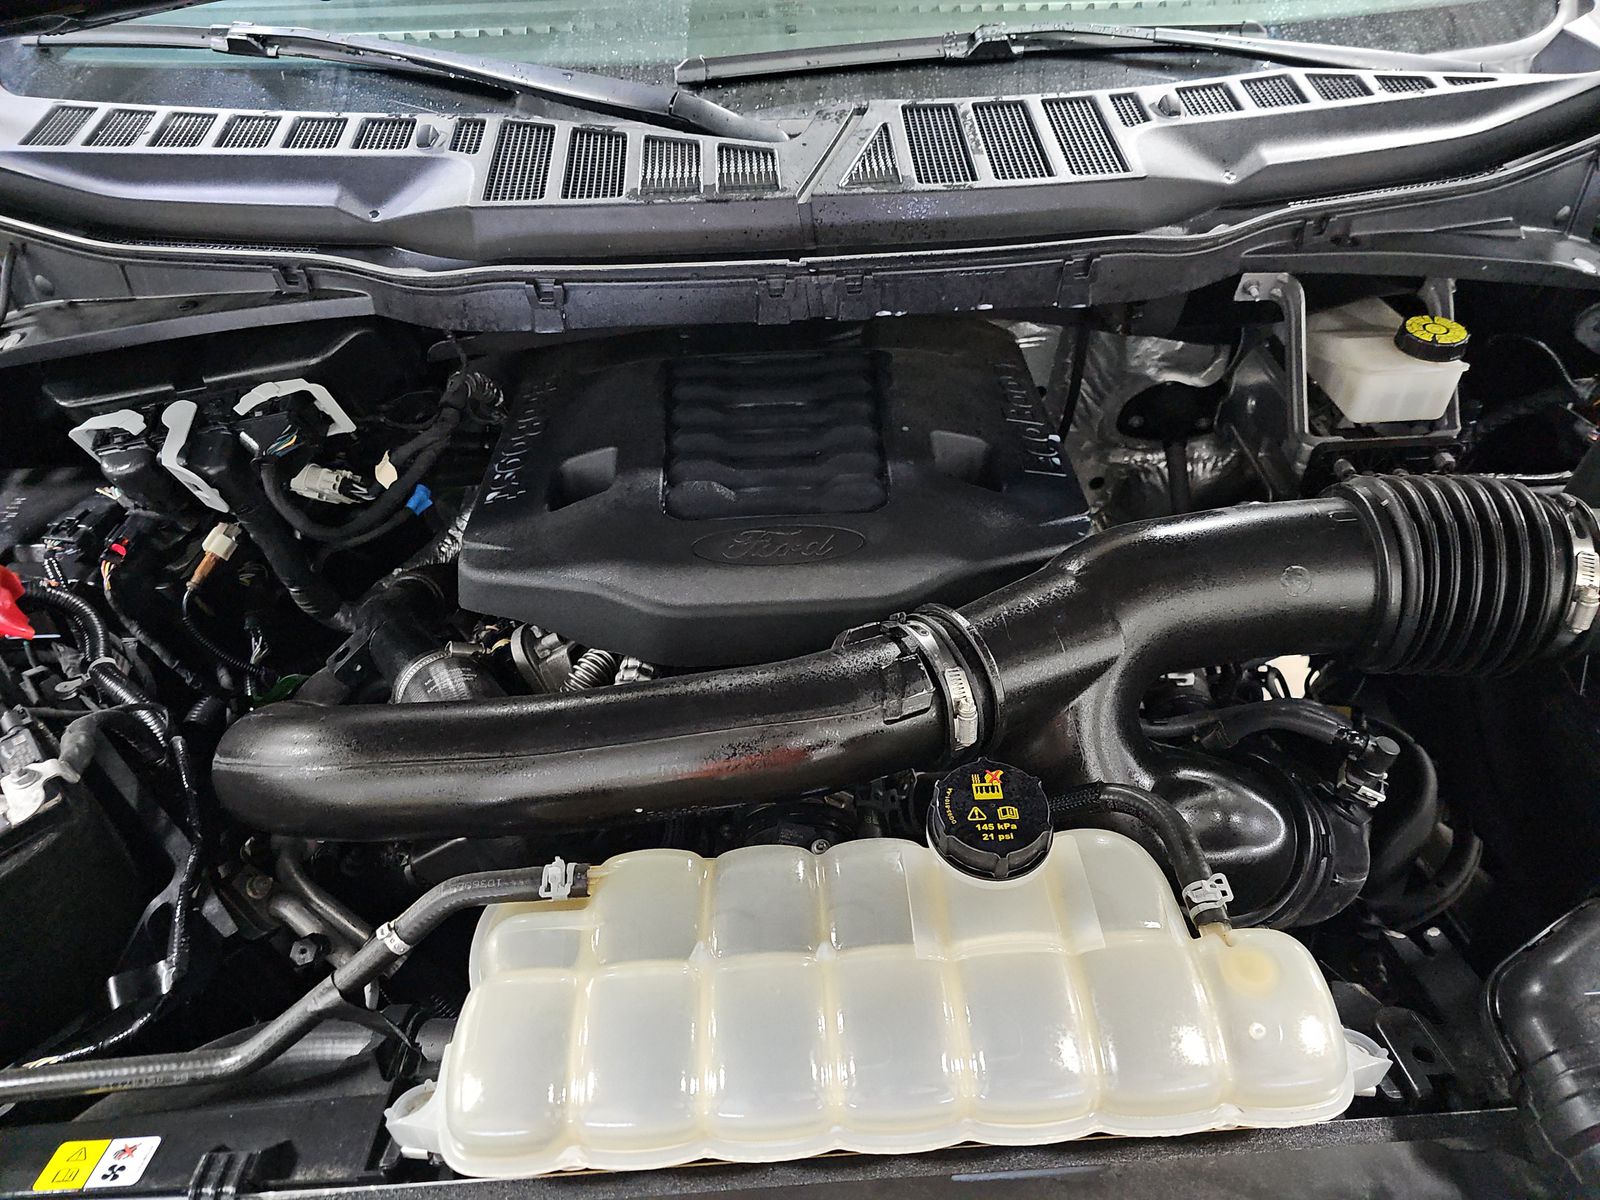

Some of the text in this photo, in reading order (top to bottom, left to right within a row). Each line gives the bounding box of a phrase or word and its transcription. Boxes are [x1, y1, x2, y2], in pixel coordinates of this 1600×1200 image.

[722, 529, 835, 559] Ford
[997, 822, 1017, 830] kPa
[998, 832, 1014, 841] psi
